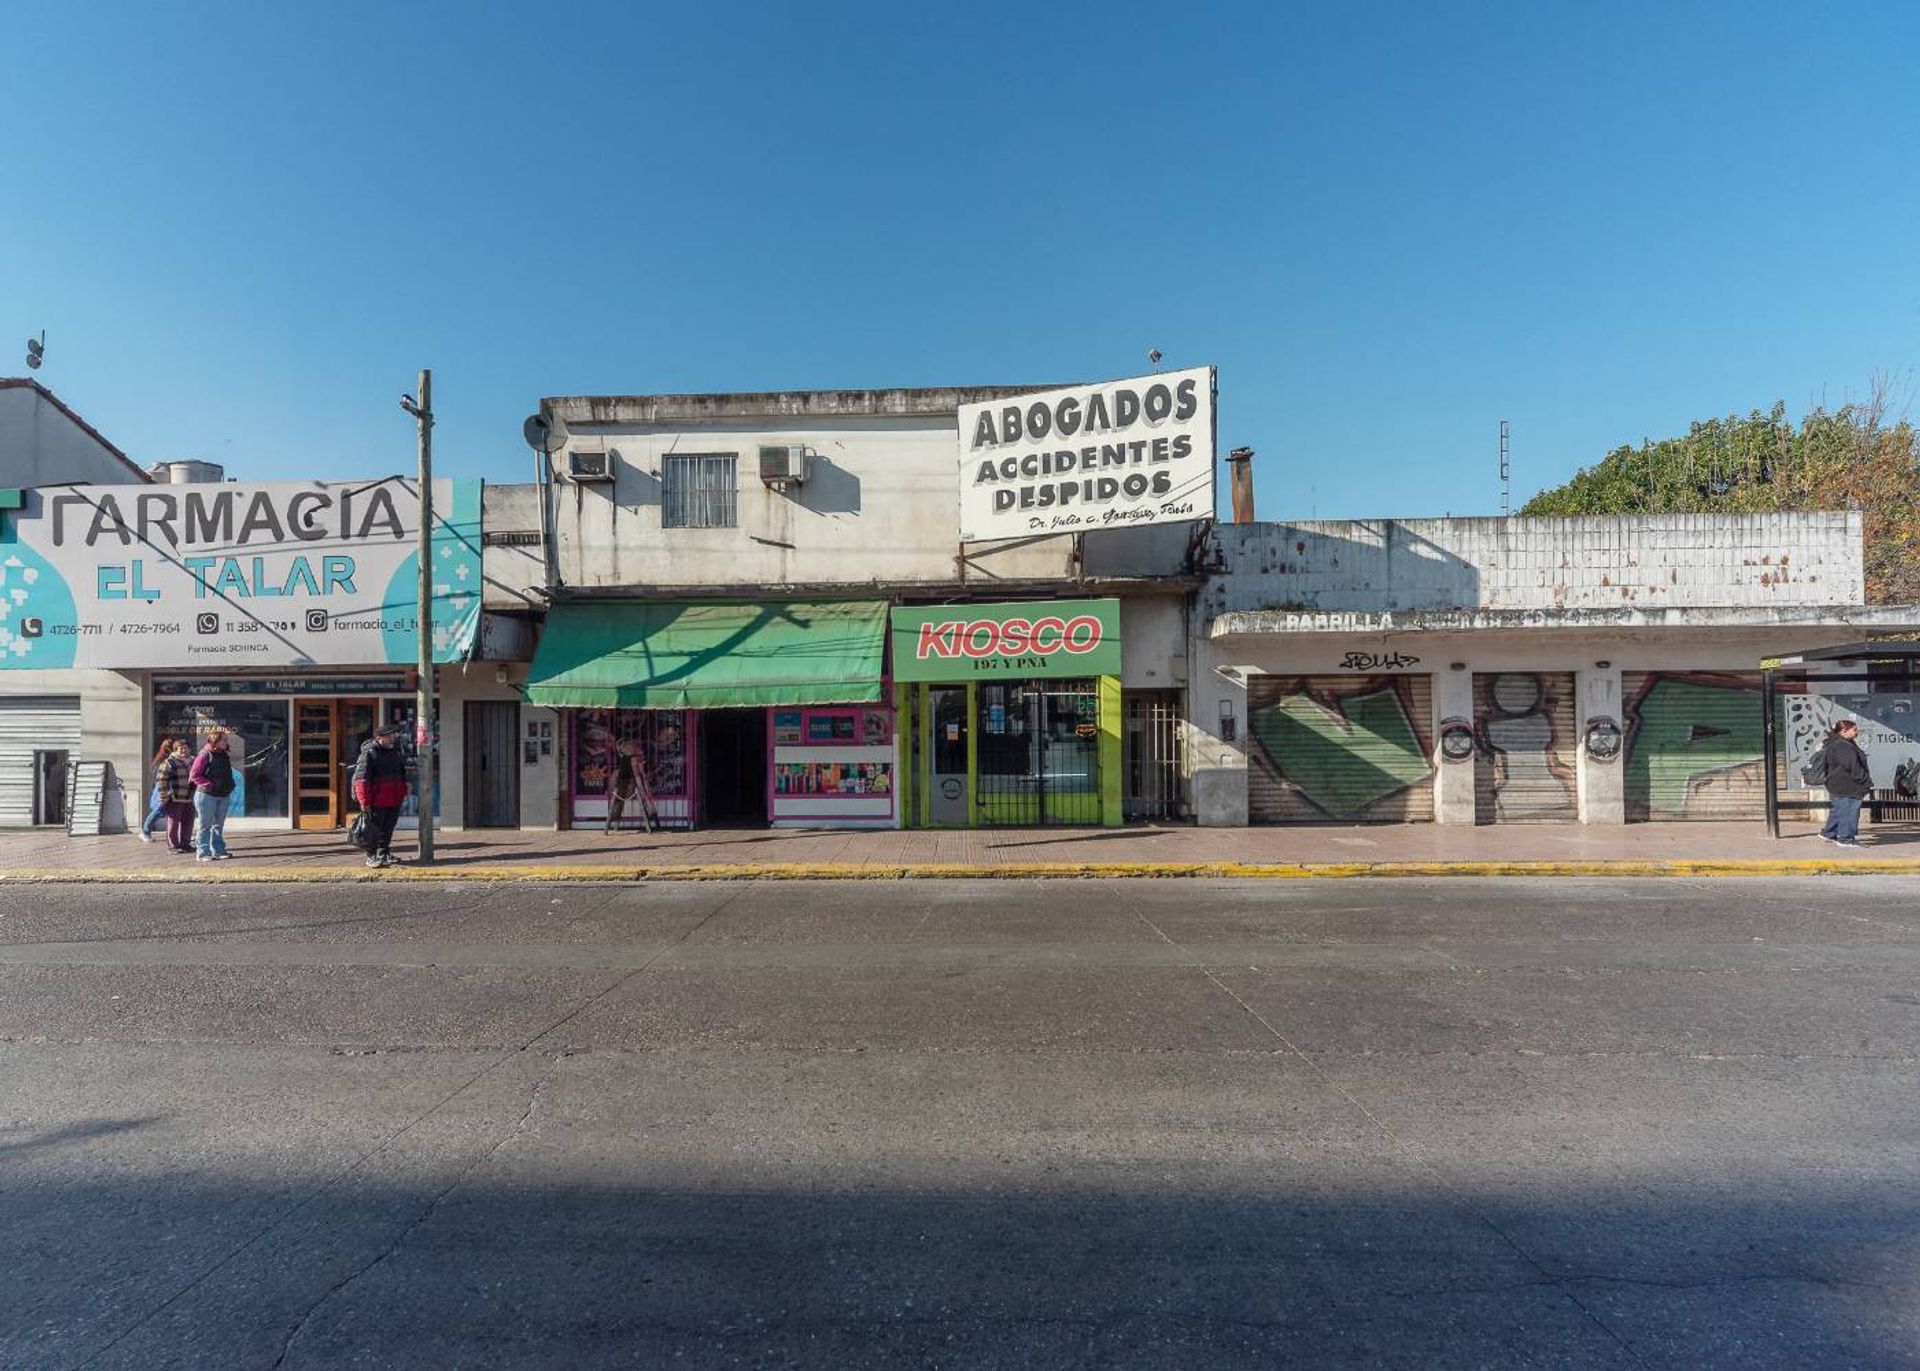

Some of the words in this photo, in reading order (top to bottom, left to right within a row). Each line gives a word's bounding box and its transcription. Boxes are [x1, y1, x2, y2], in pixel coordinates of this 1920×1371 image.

[972, 379, 1197, 449] ABOGADOS
[975, 434, 1192, 486] ACCIDENTES
[994, 470, 1171, 513] DESPIDOS
[52, 486, 405, 547] FARMACIA
[1029, 516, 1047, 529] Dr.
[98, 559, 160, 600] EL
[184, 555, 357, 599] TALAR
[120, 623, 180, 634] 4726-7964
[1286, 612, 1395, 630] PARRILLA
[188, 644, 226, 653] Farmacia
[917, 615, 1103, 660] KIOSCO
[973, 658, 998, 670] 197
[1003, 658, 1013, 670] Y
[1018, 656, 1047, 669] PNA
[1877, 733, 1914, 743] TIGRE
